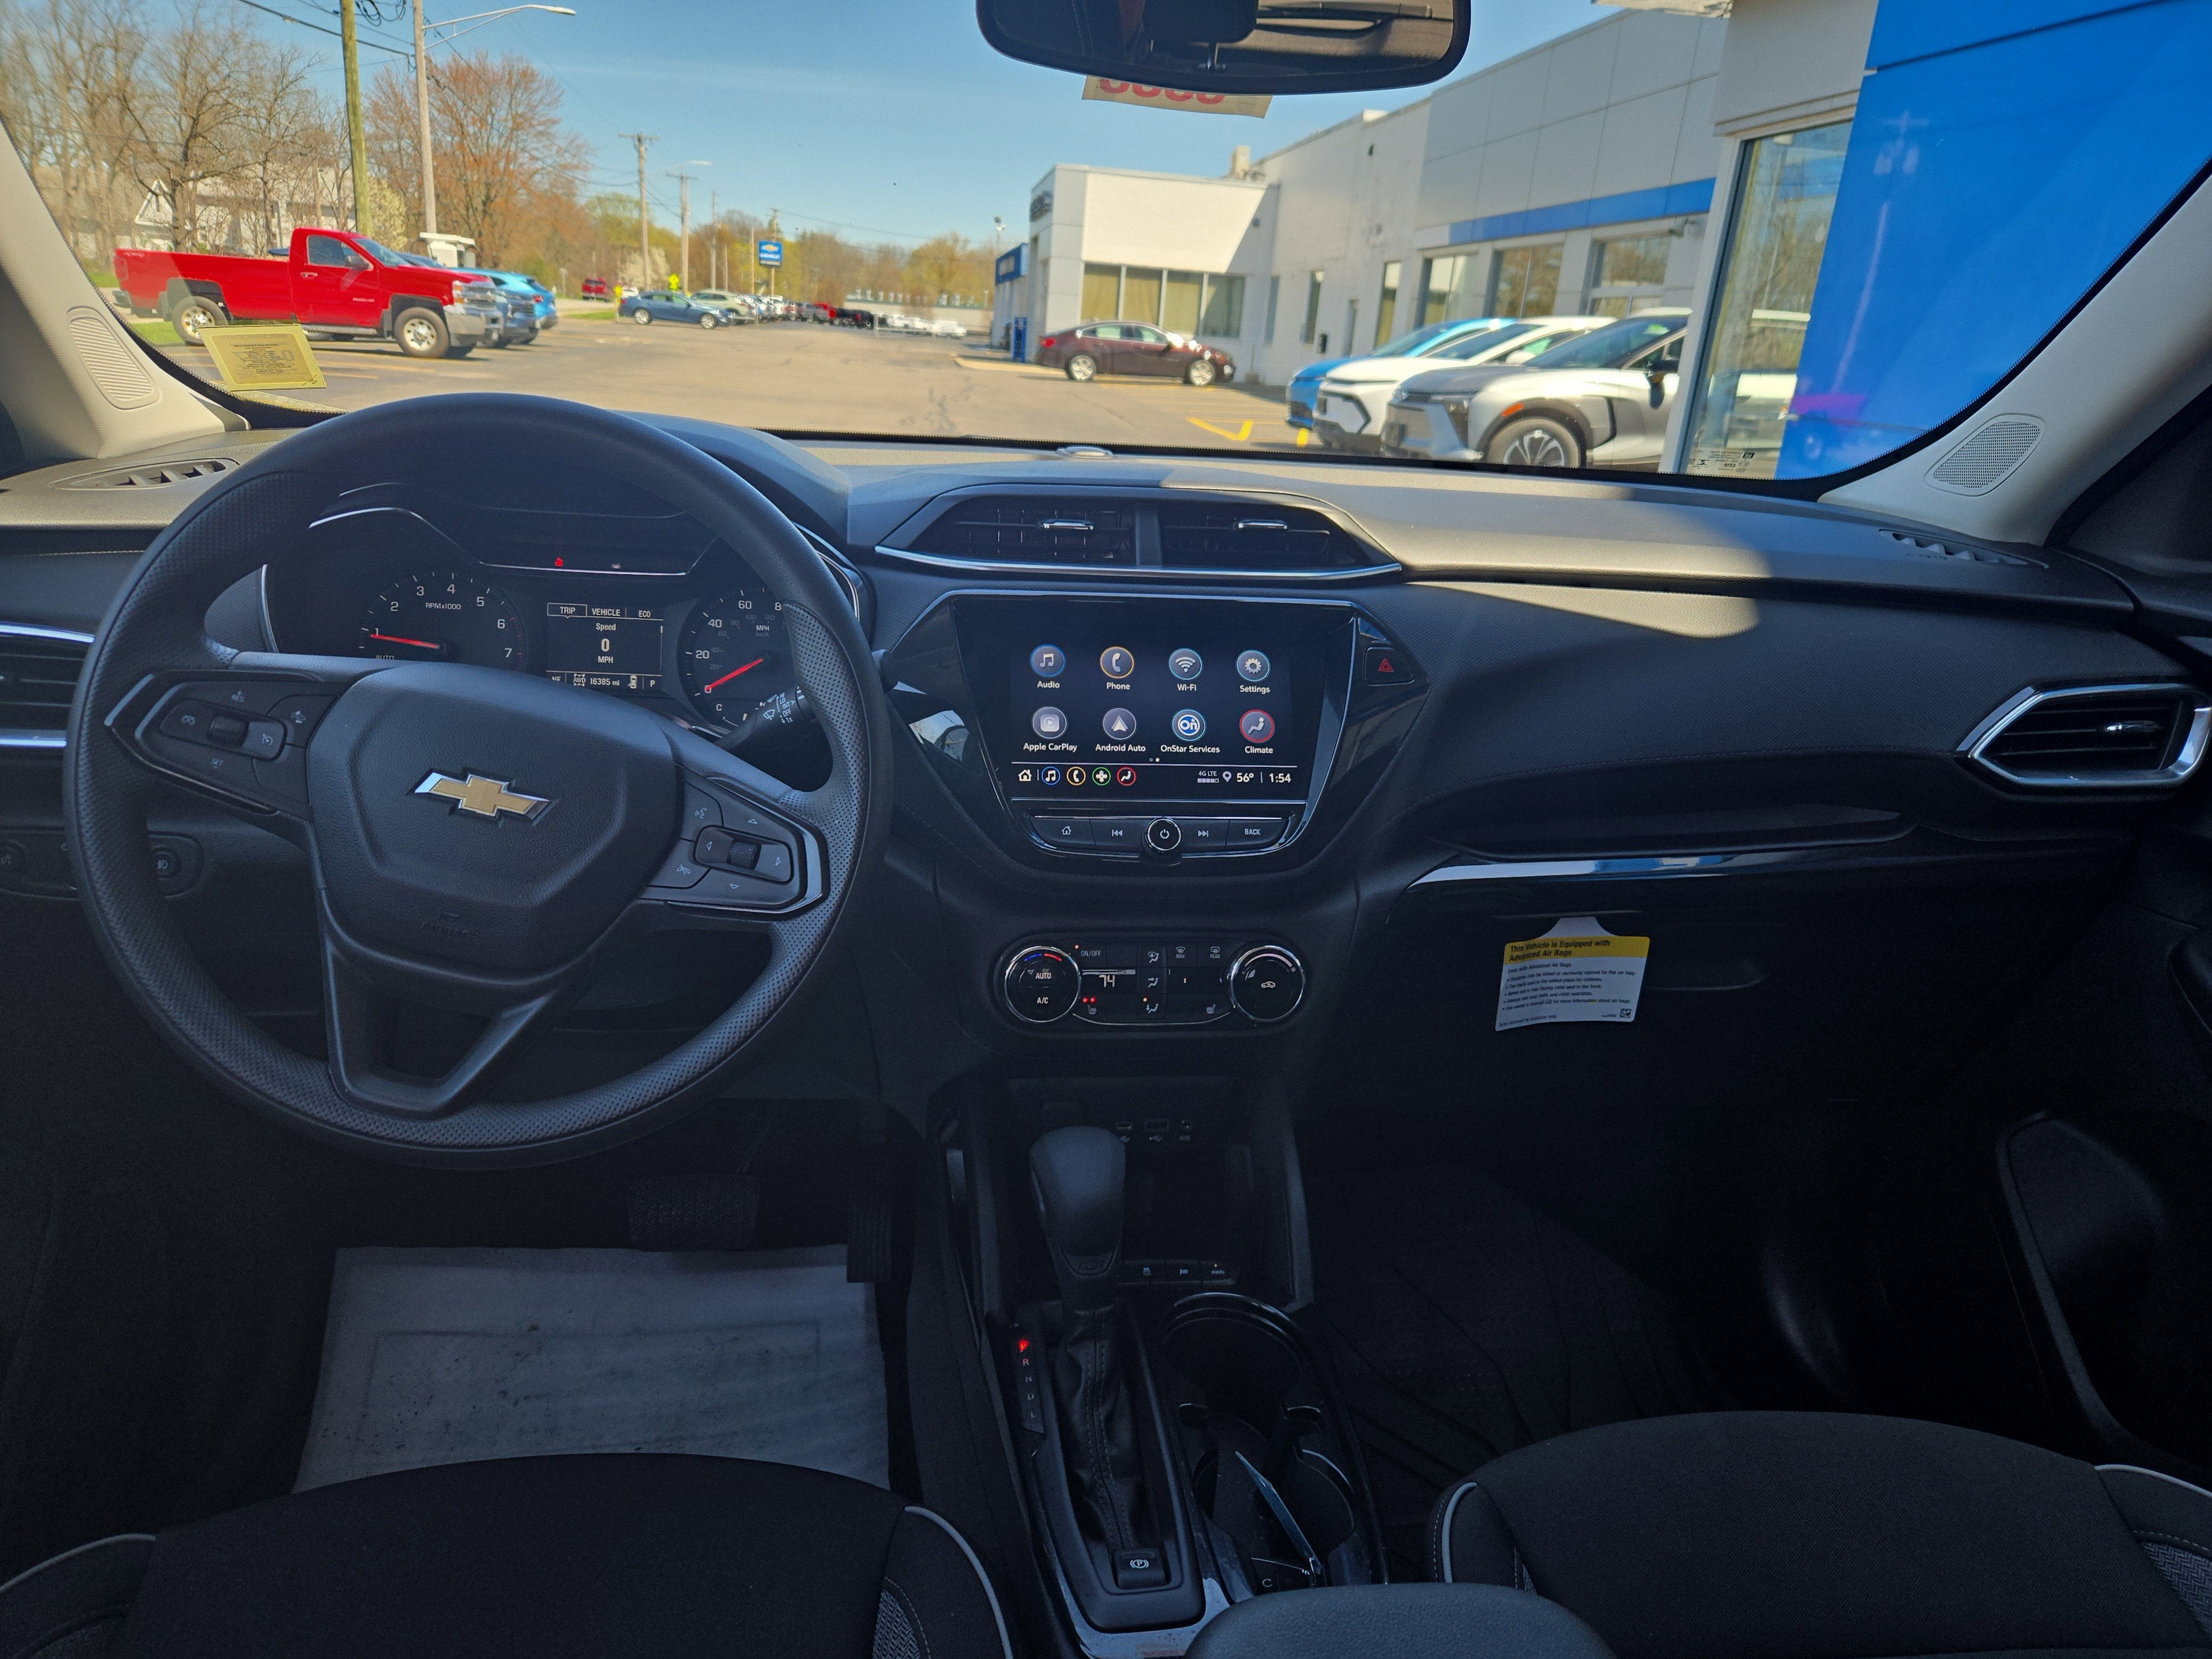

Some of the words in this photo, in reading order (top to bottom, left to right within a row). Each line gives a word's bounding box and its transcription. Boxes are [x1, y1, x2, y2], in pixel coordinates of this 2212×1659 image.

[416, 586, 425, 596] 3
[447, 583, 455, 594] 4
[425, 602, 461, 610] RPMx1000
[476, 596, 485, 607] 5
[738, 600, 752, 609] 60
[390, 601, 398, 612] 2
[774, 602, 782, 611] 8
[591, 608, 621, 616] VEHICLE
[497, 619, 505, 629] 6
[596, 623, 616, 631] Speed
[708, 619, 722, 628] 40
[601, 638, 610, 652] 0
[504, 647, 512, 658] 7
[696, 650, 710, 659] 20
[1037, 681, 1060, 689] Audio
[1106, 682, 1130, 690] Phone
[1176, 683, 1197, 692] Wi-Fi
[1239, 685, 1271, 695] Settings
[782, 708, 791, 717] OFF
[1023, 743, 1047, 753] Apple
[1049, 743, 1078, 753] CarPlay
[1095, 743, 1126, 752] Android
[1127, 744, 1147, 753] Auto
[1160, 744, 1187, 753] OnStar
[1189, 745, 1220, 754] Services
[1244, 745, 1274, 754] Climate
[1269, 773, 1291, 783] 1:54
[1244, 827, 1261, 836] BACK
[1526, 942, 1549, 950] Vehicle
[1559, 940, 1592, 948] Equipped
[1509, 951, 1540, 962] Advanced
[1554, 949, 1572, 957] Bags
[1035, 972, 1052, 980] AUTO
[1098, 974, 1115, 988] 74
[1037, 996, 1049, 1005] A/C
[1023, 1358, 1030, 1366] R
